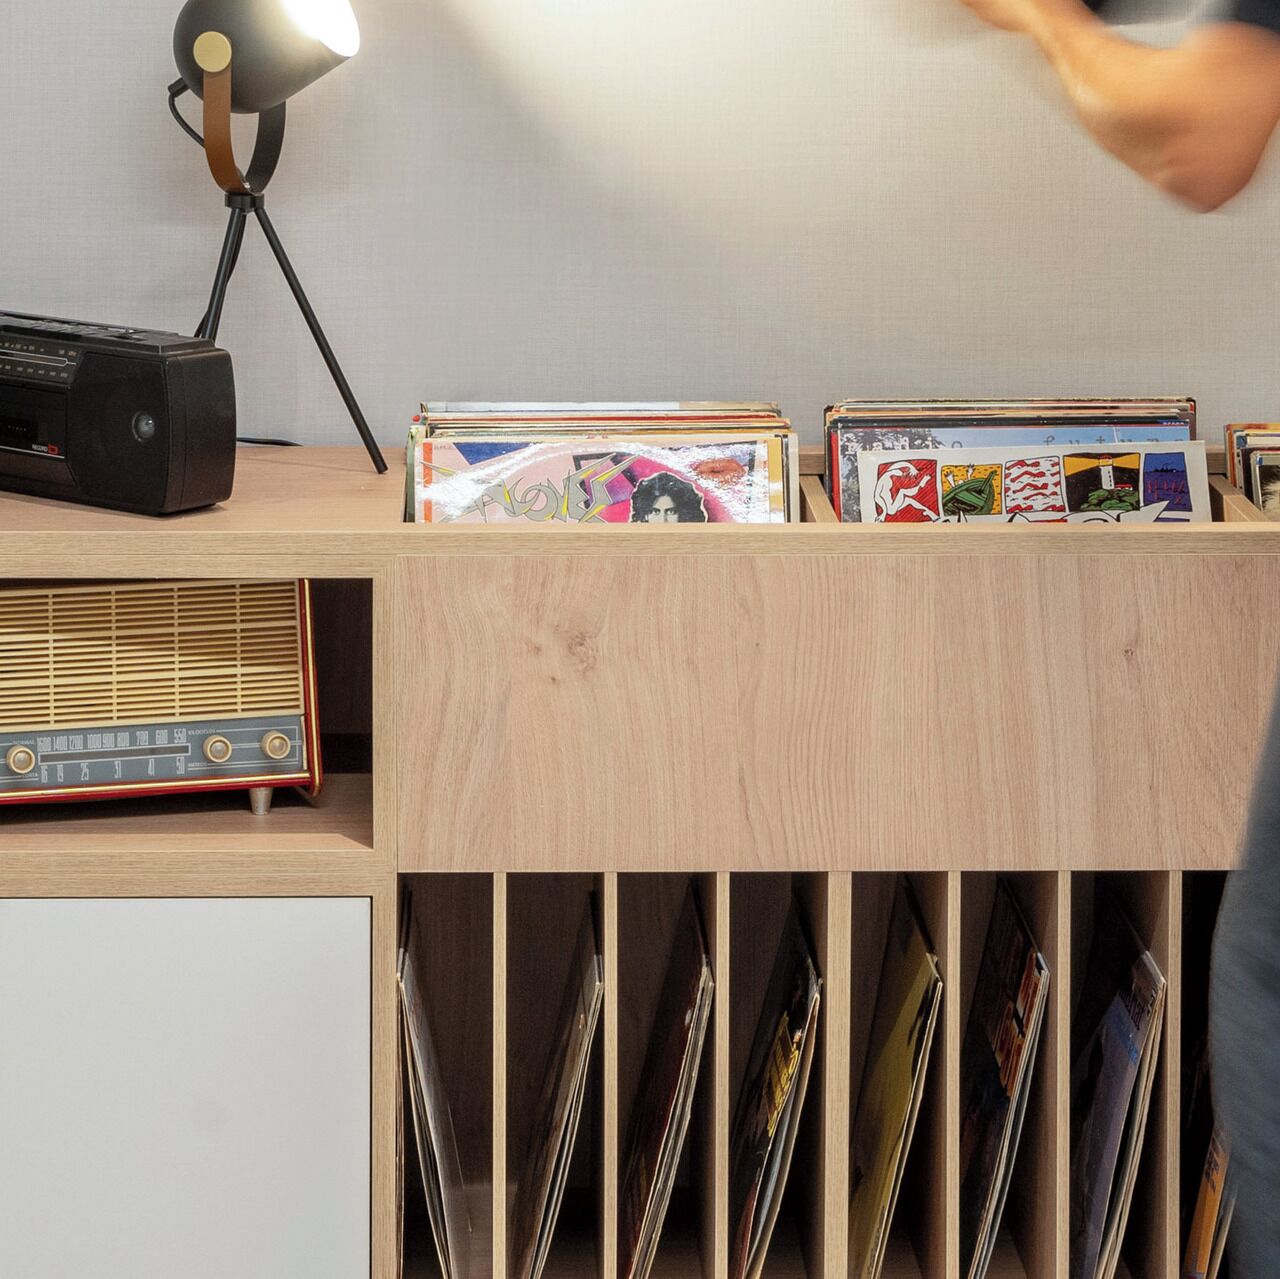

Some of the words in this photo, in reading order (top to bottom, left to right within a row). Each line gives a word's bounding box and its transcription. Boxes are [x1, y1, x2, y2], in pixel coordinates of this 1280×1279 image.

[53, 735, 67, 751] 1400
[87, 733, 101, 749] 1000
[174, 728, 187, 743] 550
[40, 765, 48, 783] 16
[80, 762, 89, 781] 25
[114, 760, 122, 779] 31
[148, 758, 155, 776] 41
[176, 756, 185, 775] 50
